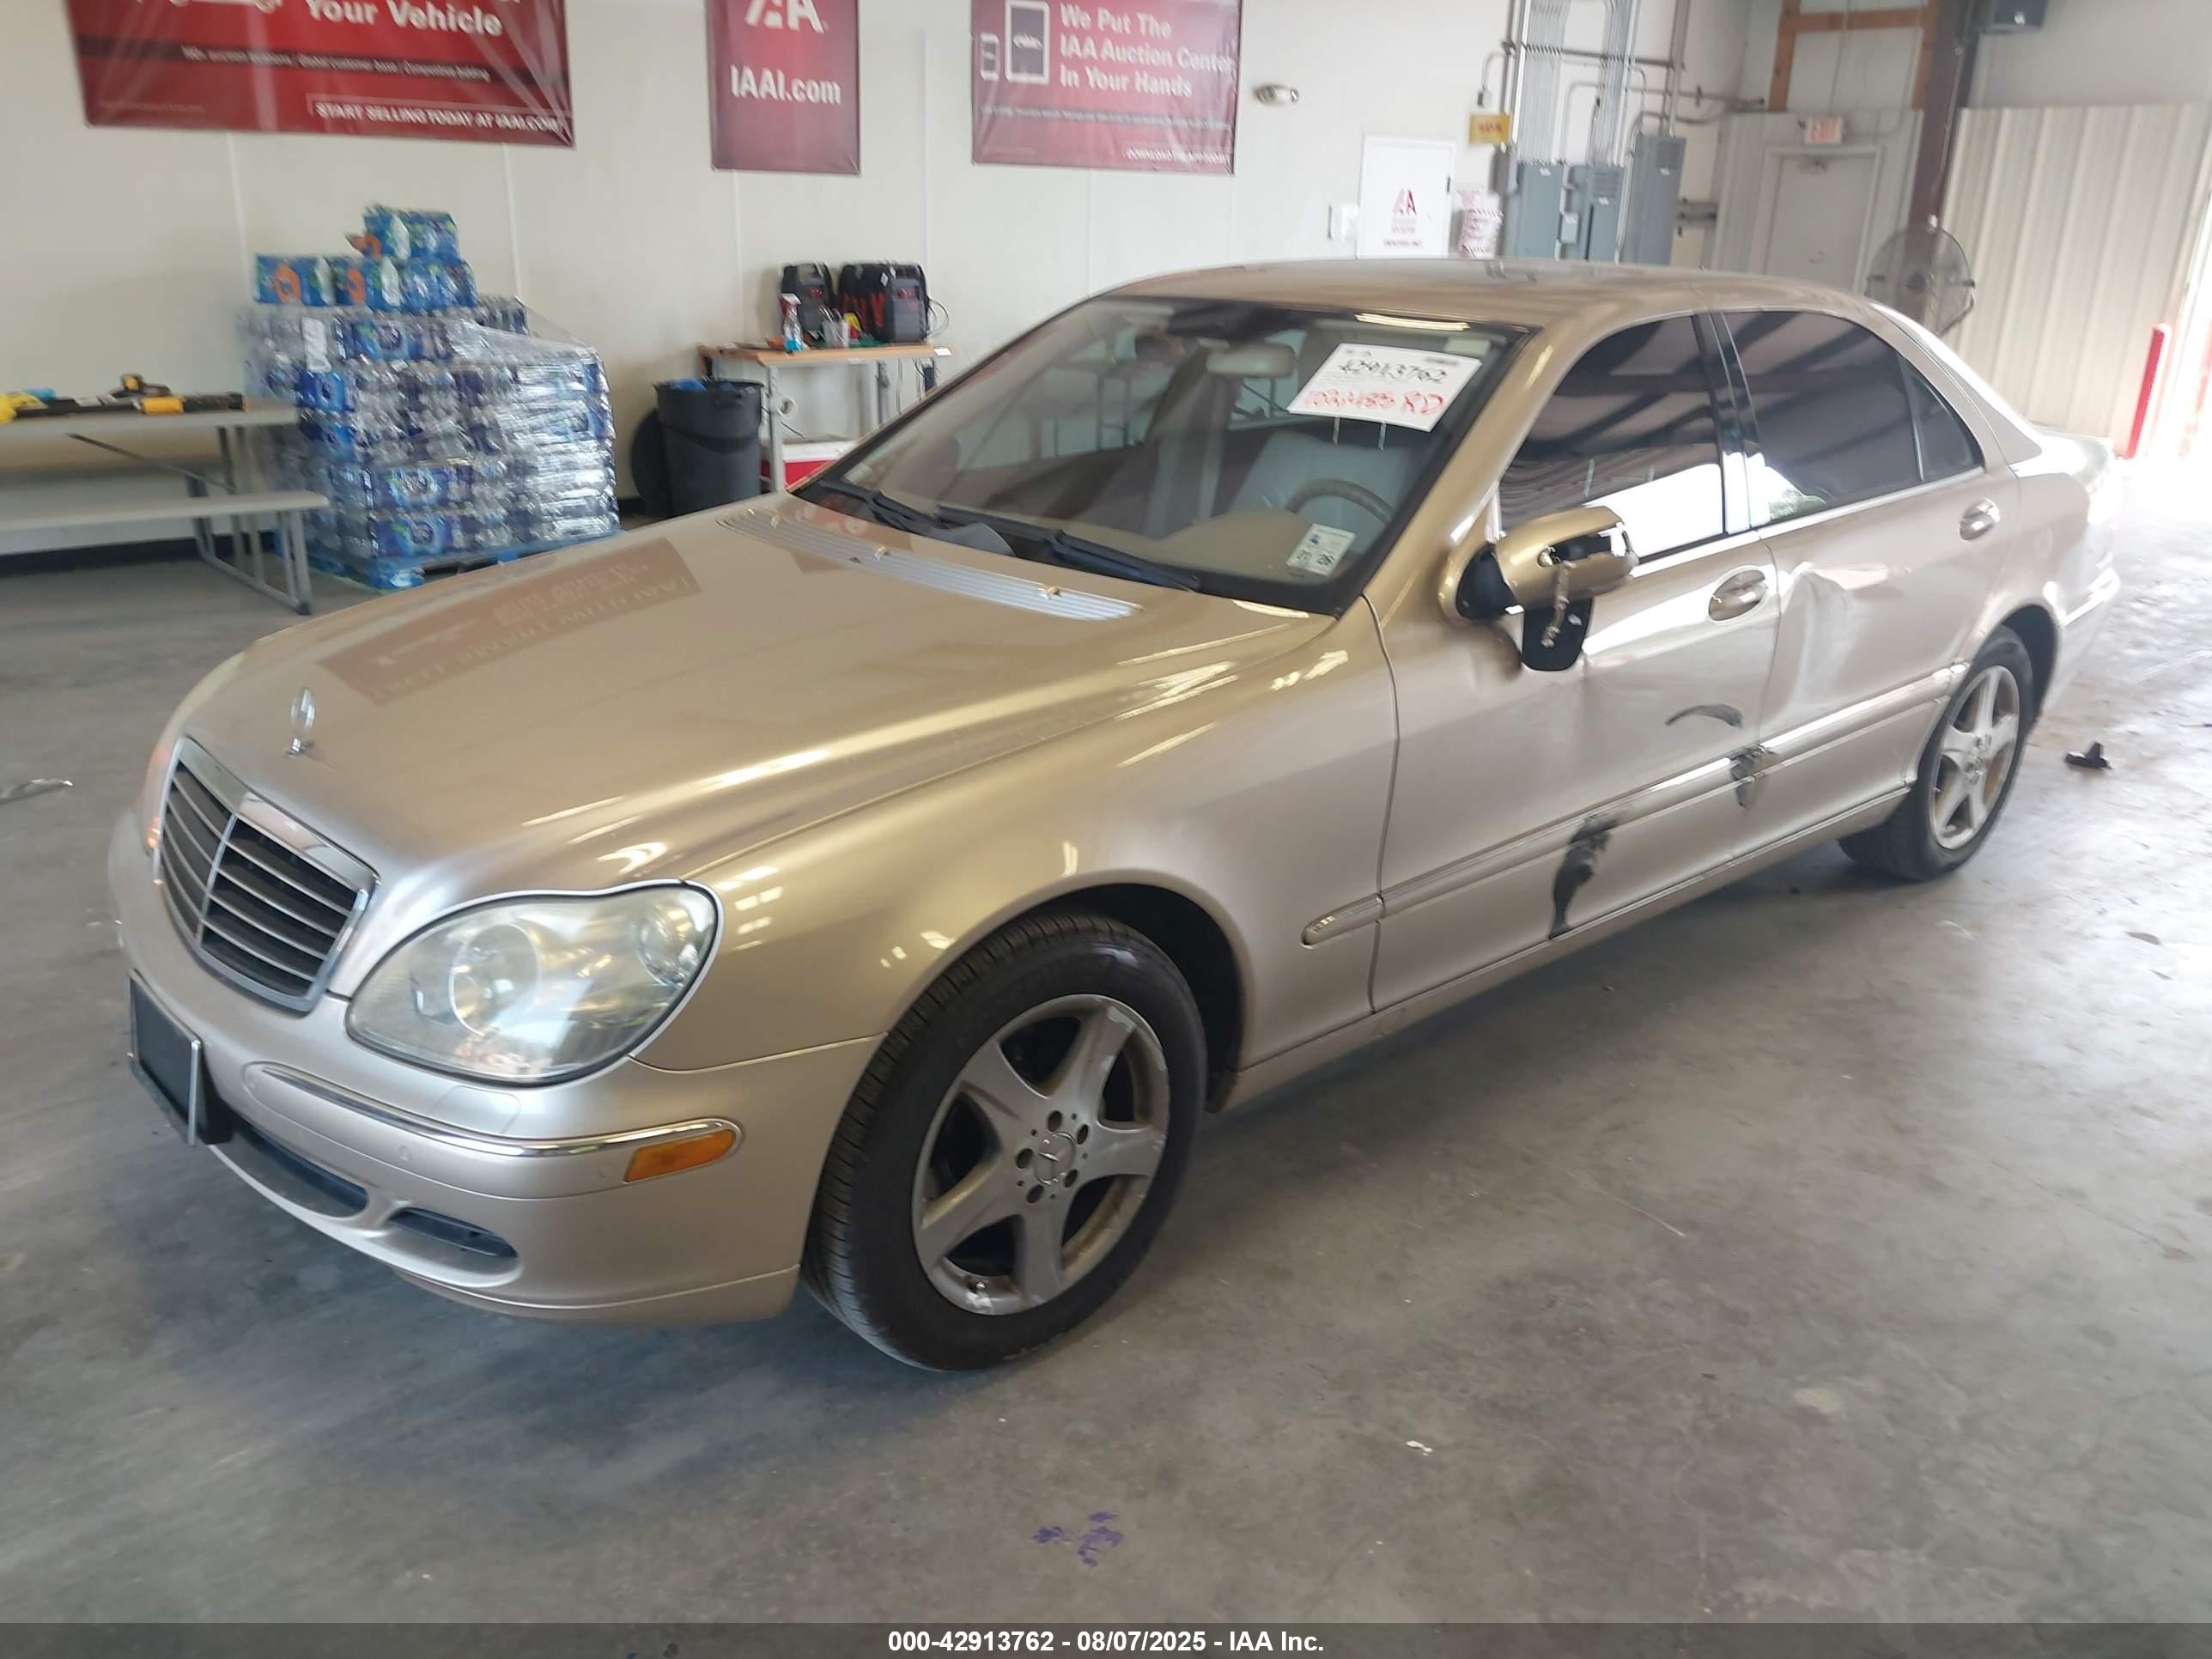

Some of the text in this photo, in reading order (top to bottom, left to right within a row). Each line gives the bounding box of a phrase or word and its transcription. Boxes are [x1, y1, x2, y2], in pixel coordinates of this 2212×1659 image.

[307, 0, 378, 25] Your
[389, 0, 503, 36] Vehicle
[1060, 3, 1172, 38] We Put The
[1060, 33, 1098, 59] IAA
[1100, 38, 1173, 67] Auction
[731, 64, 842, 105] IAAI.com
[1060, 64, 1193, 97] In Your Hands
[315, 101, 363, 119] START
